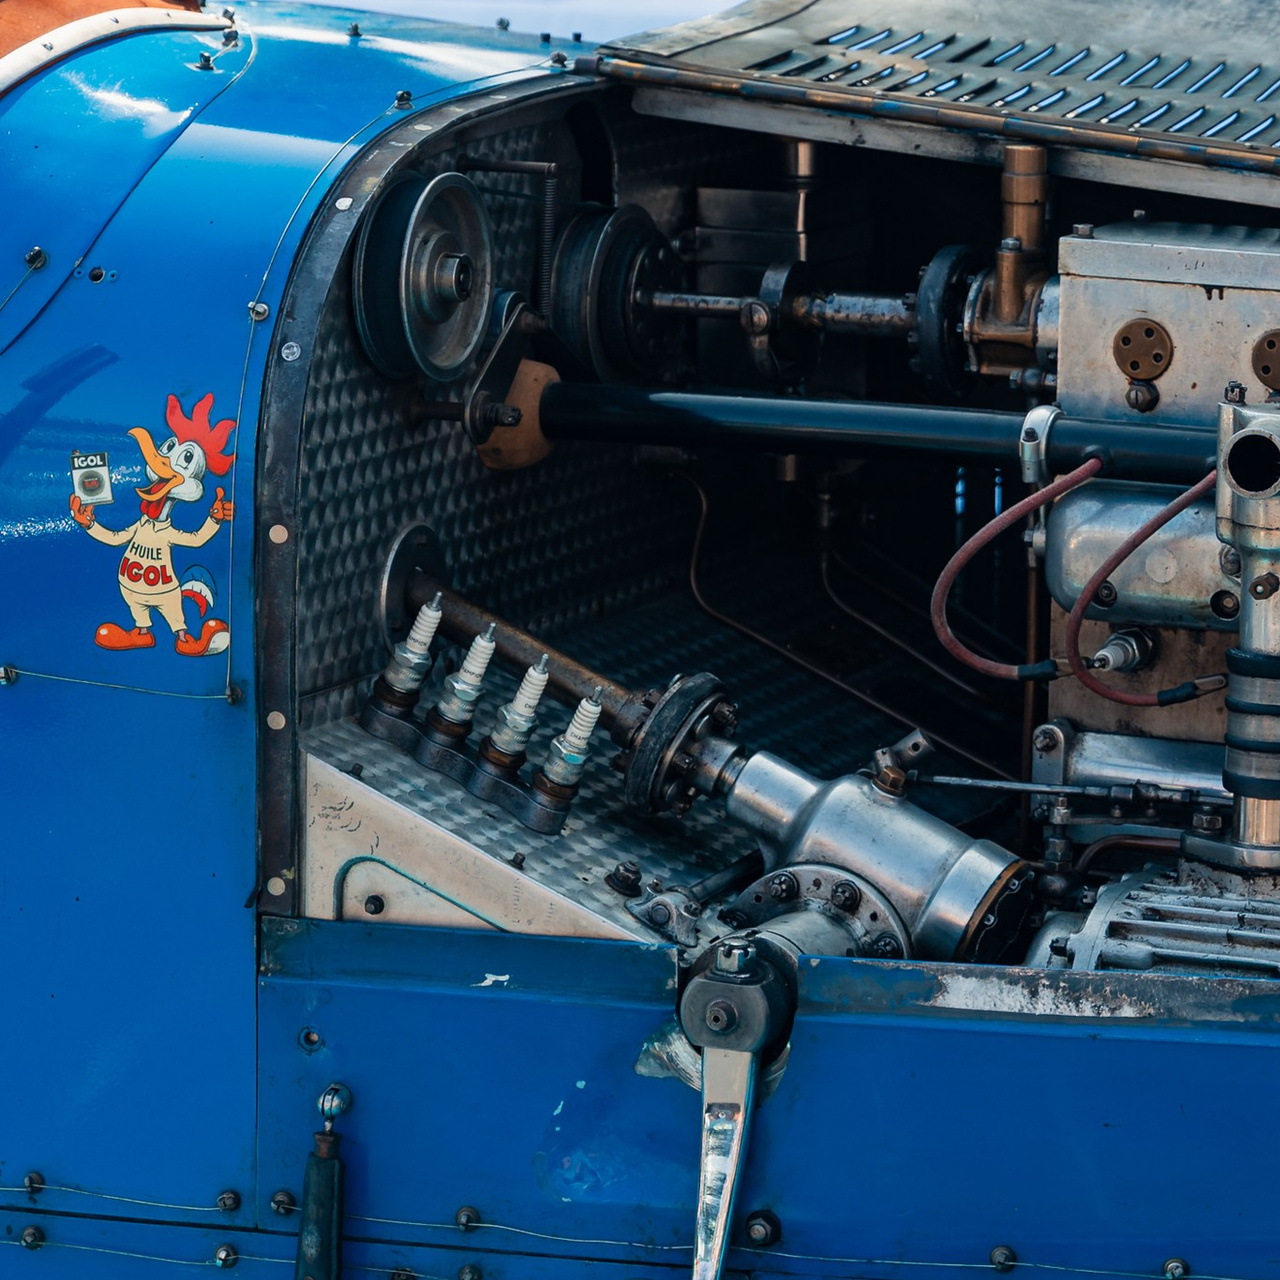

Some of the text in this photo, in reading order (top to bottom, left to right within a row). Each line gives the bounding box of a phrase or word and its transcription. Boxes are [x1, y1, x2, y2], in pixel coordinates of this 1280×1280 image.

[74, 455, 104, 468] IGOL
[130, 543, 163, 561] HUILE
[120, 556, 173, 587] IGOL
